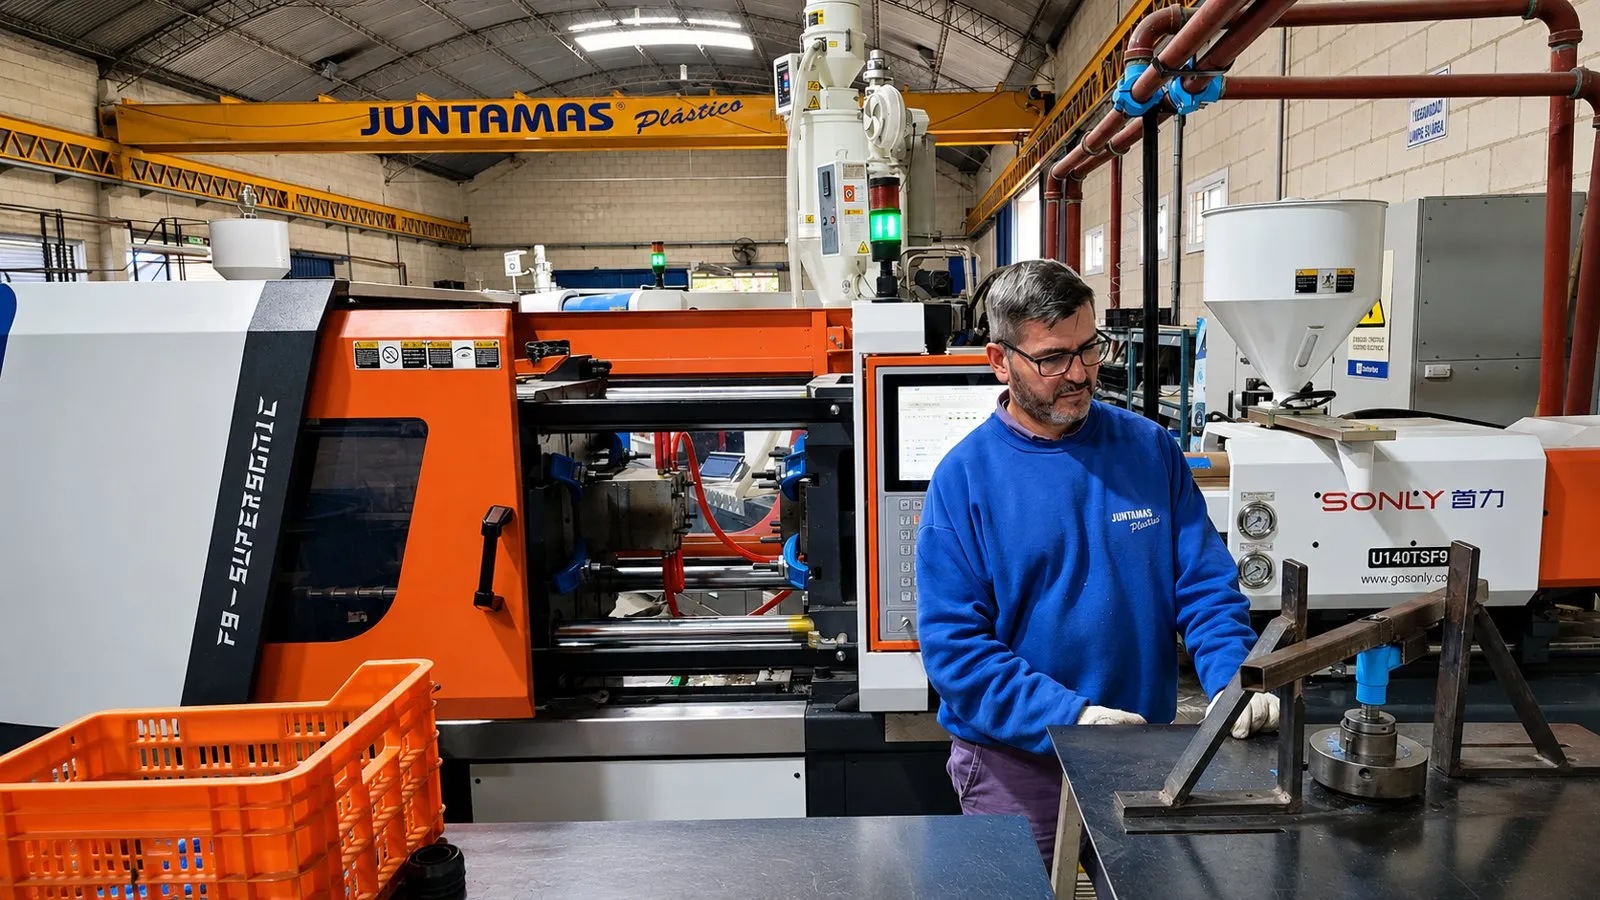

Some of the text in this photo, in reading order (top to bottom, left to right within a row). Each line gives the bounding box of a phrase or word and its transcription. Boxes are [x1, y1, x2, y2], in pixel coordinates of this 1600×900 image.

[361, 100, 743, 136] JUNTAMAS Plástico
[1321, 488, 1505, 512] SONLY 首力
[1111, 508, 1153, 523] JUNTAMAS
[1371, 549, 1448, 566] U140TSF9
[1360, 571, 1448, 587] www.gosonly.co
